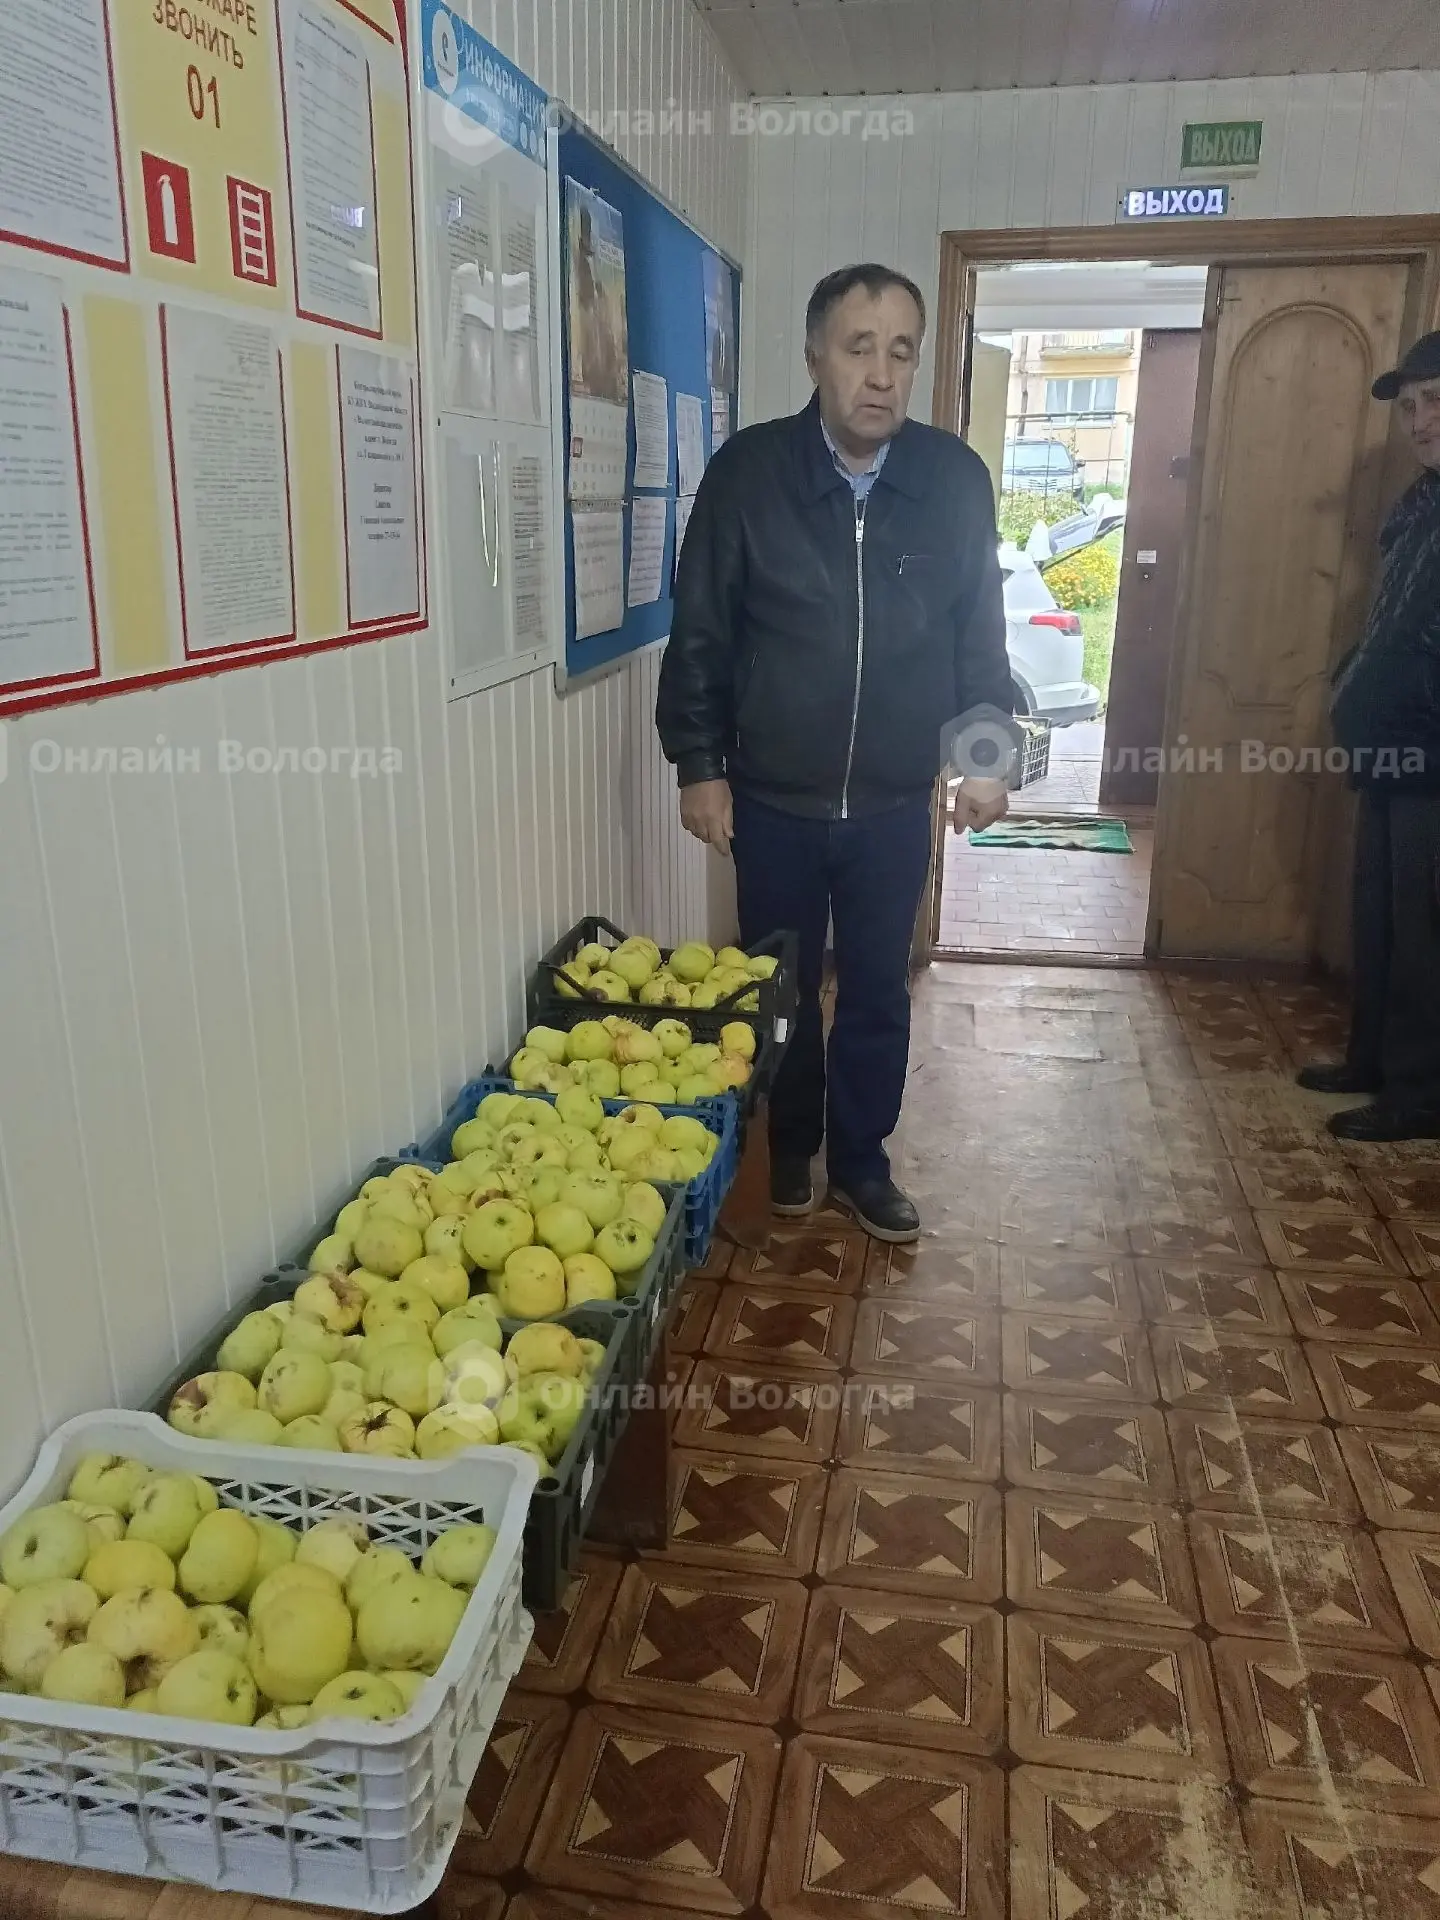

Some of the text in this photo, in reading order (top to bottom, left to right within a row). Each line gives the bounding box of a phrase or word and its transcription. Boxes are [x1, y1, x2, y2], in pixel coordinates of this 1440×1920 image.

[153, 0, 244, 69] ЗВОНИТЬ
[198, 0, 257, 35] АРЕ
[187, 64, 221, 129] 01
[464, 37, 547, 132] ИНФОРМАЦИЯ
[1190, 129, 1257, 163] ВЫХОД
[1128, 188, 1224, 216] ВЫХОД
